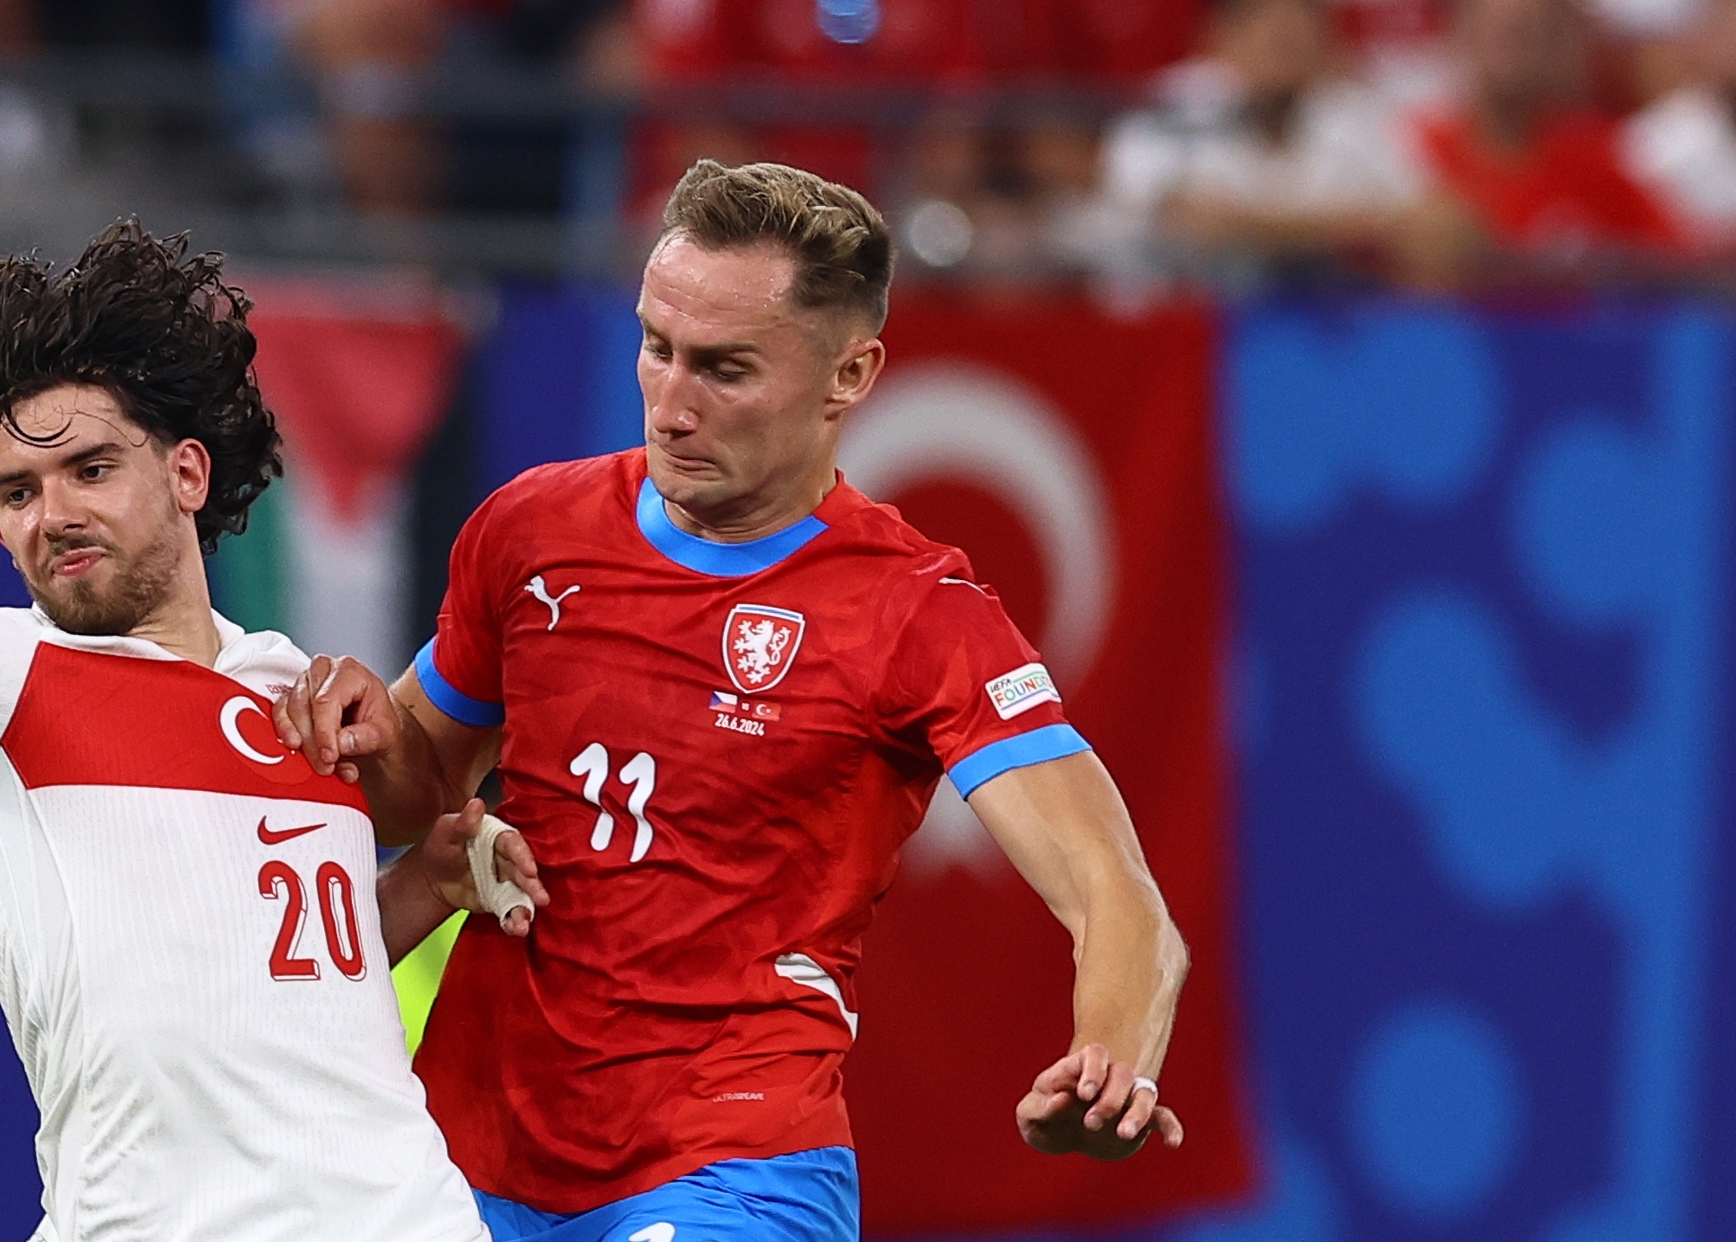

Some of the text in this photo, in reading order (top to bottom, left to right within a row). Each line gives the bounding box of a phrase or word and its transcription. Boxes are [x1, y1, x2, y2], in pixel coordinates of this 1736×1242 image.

[990, 678, 1012, 693] UEFA
[714, 713, 765, 737] 26.6.2024
[569, 741, 657, 864] 11
[257, 860, 367, 982] 20
